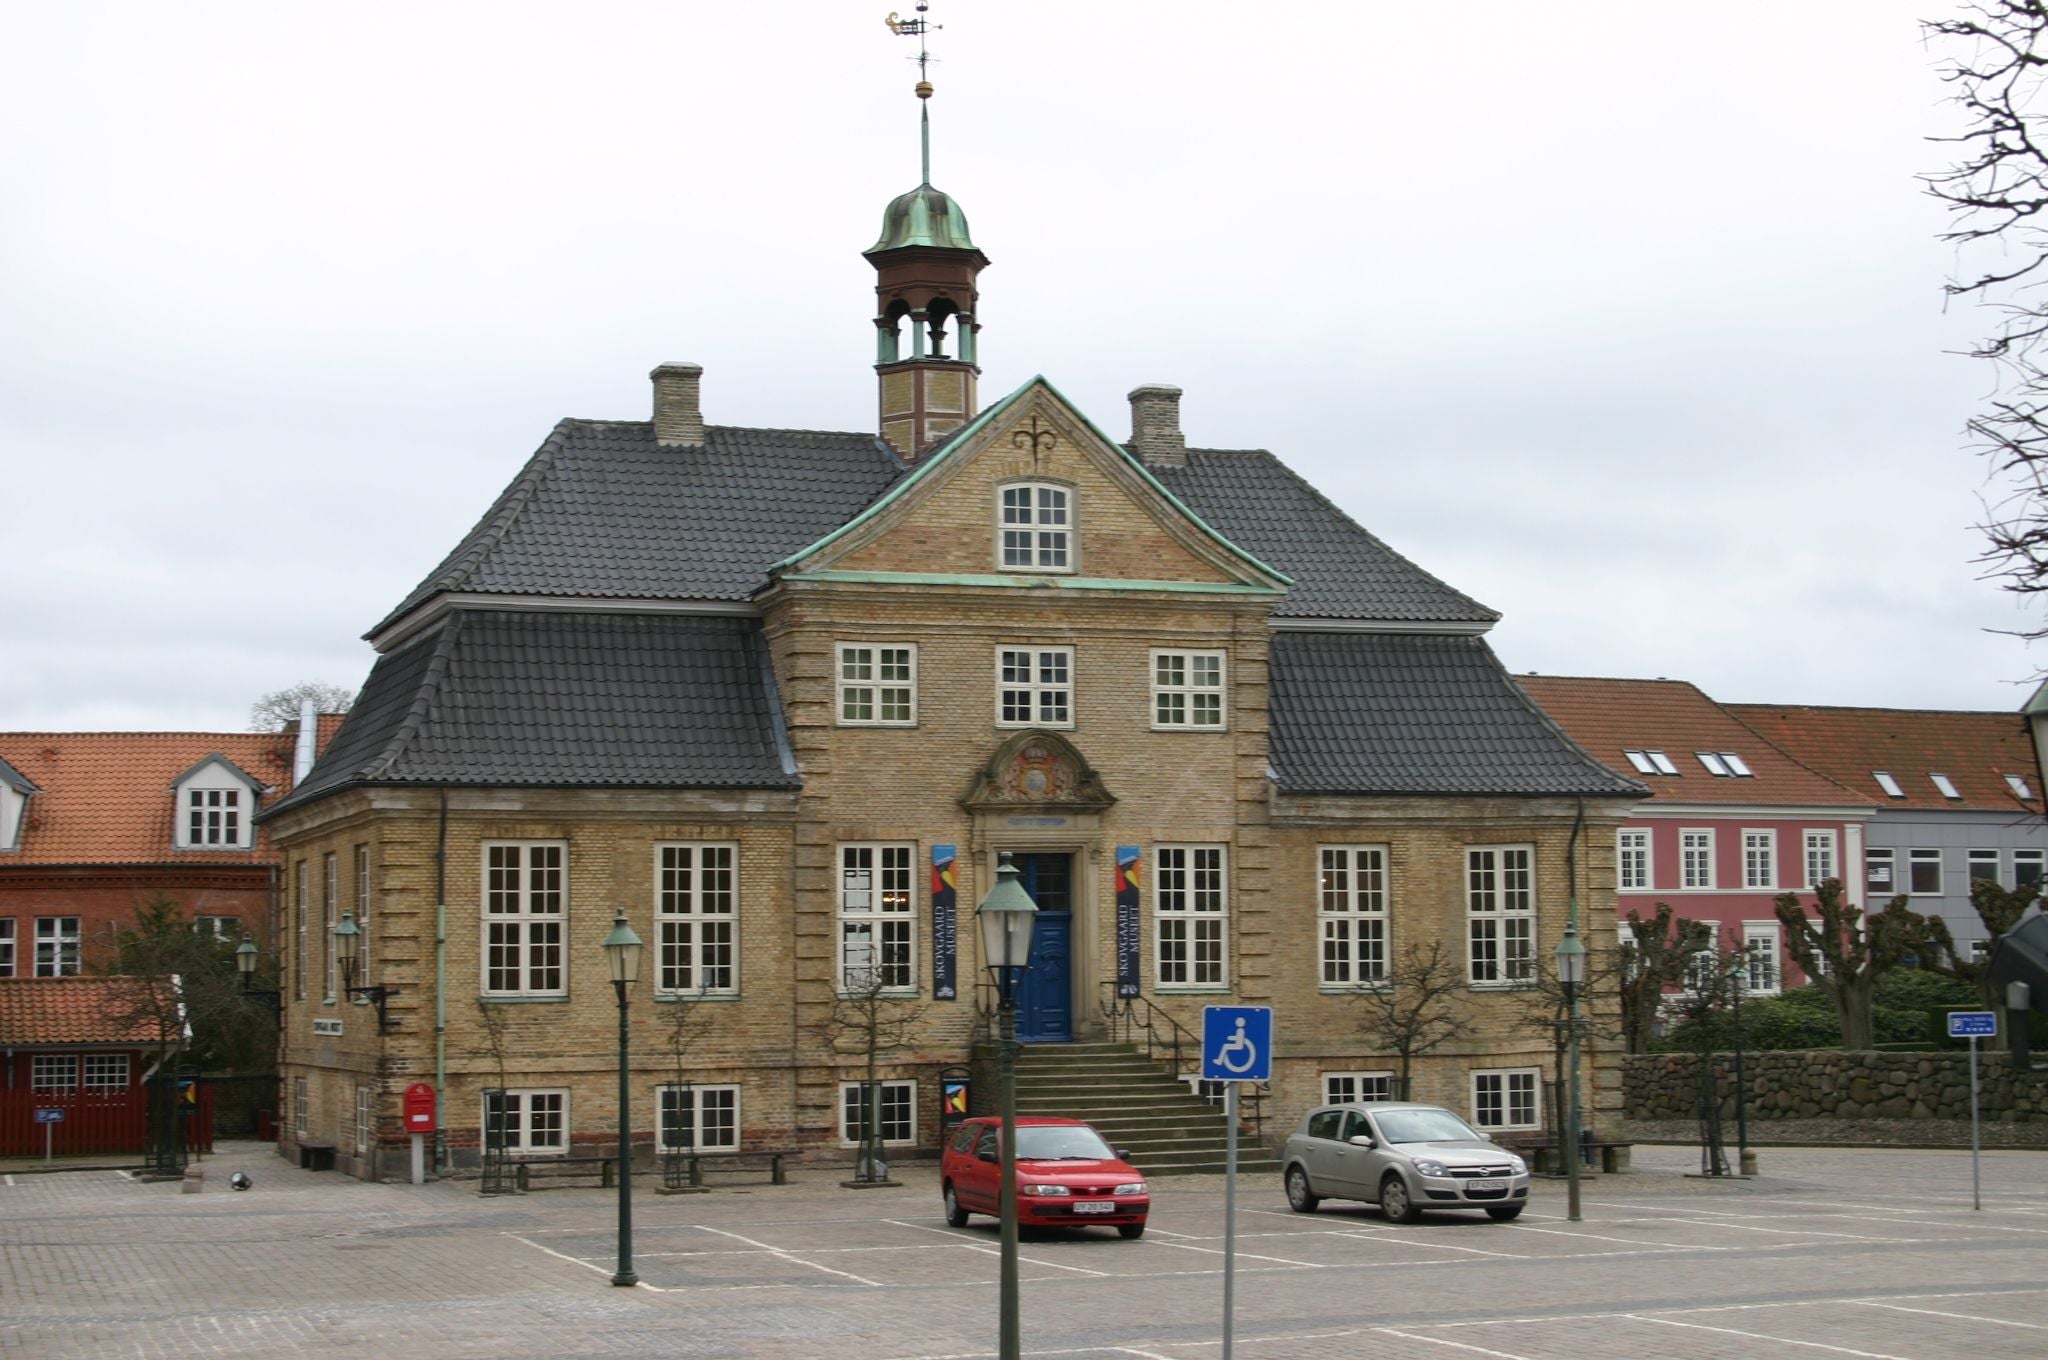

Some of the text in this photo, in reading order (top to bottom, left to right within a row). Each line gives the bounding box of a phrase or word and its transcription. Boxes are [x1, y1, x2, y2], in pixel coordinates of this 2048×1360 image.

[934, 906, 945, 979] SKOVGAARD
[945, 906, 956, 955] MUSEET
[1119, 904, 1129, 977] SKOVGAARD
[1129, 904, 1139, 953] MUSEET
